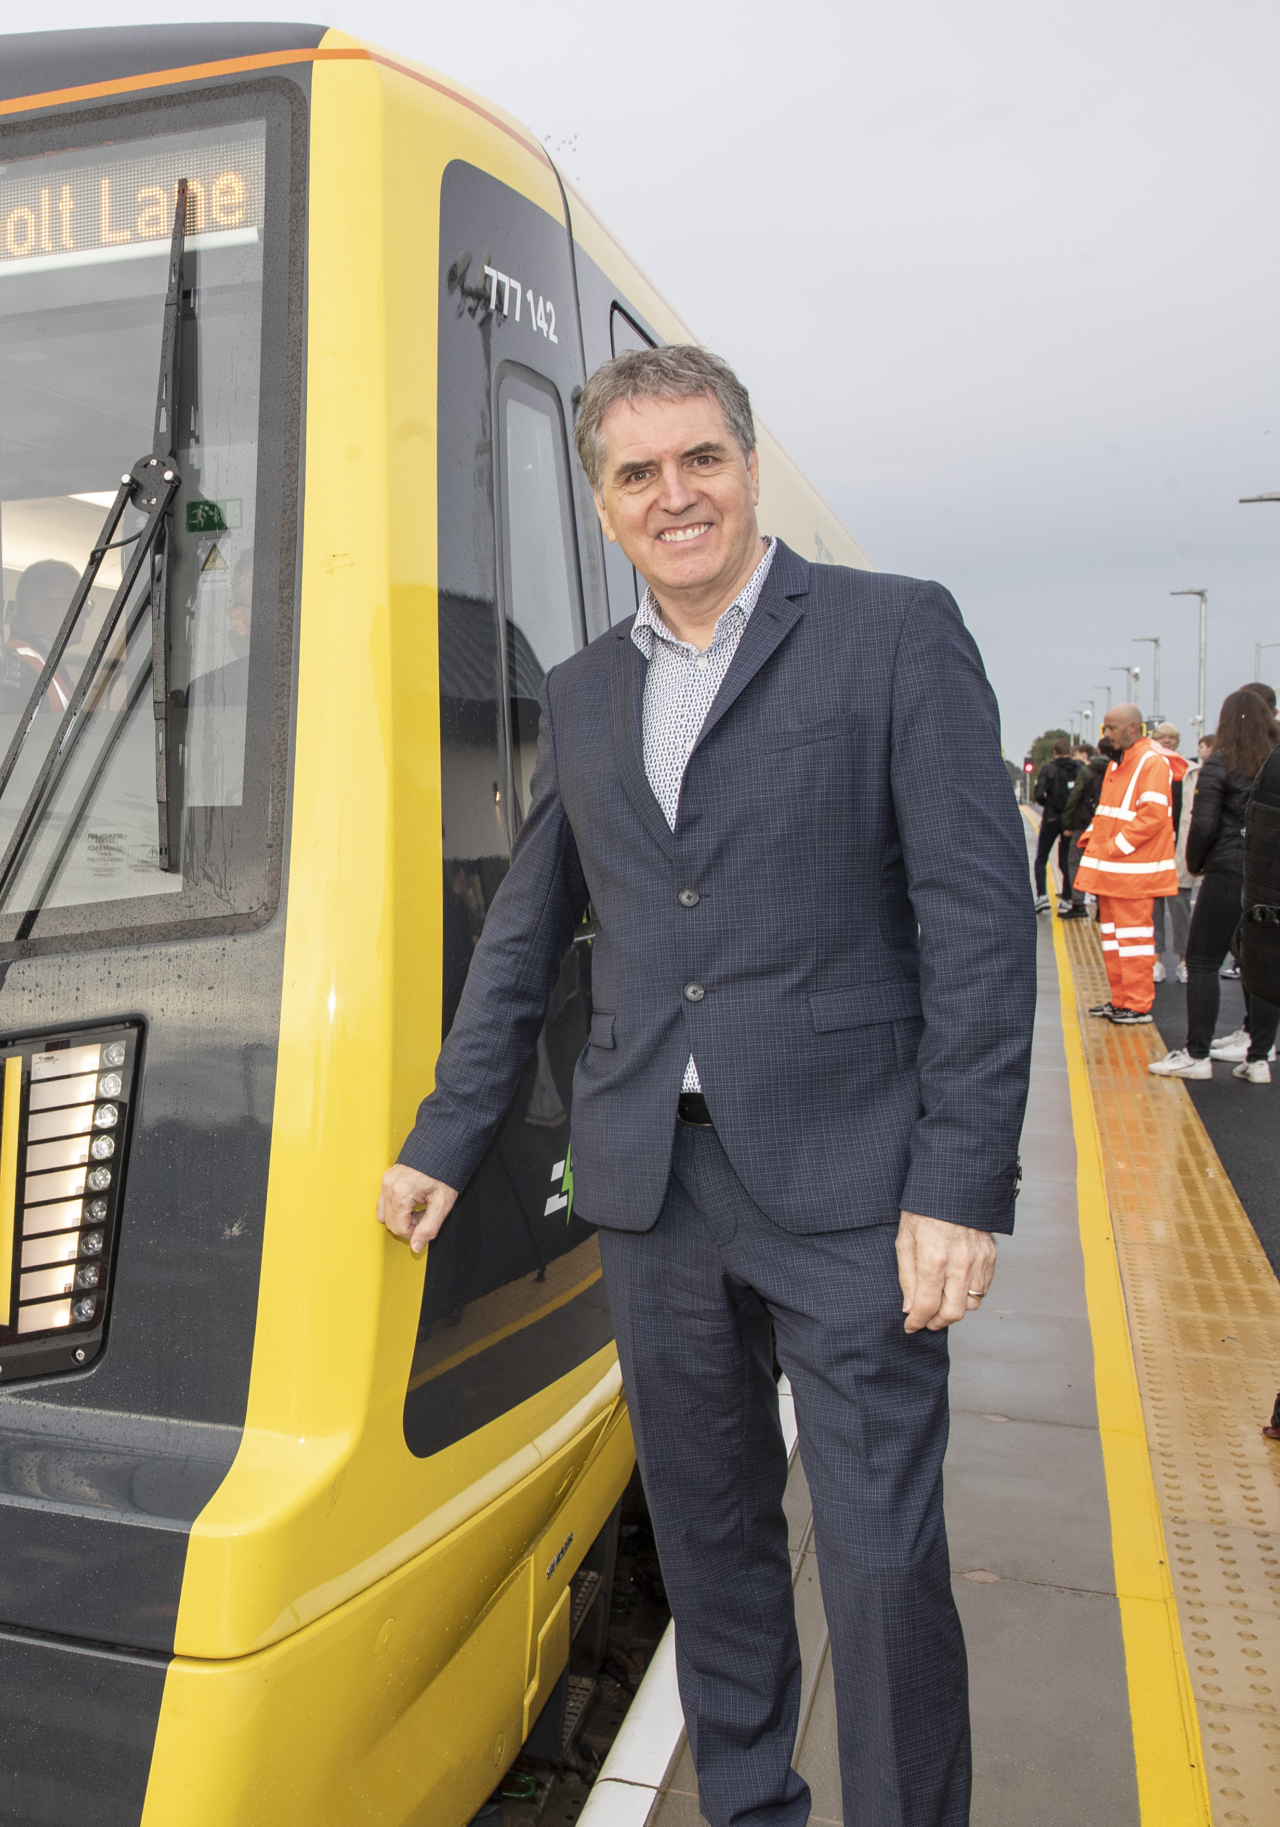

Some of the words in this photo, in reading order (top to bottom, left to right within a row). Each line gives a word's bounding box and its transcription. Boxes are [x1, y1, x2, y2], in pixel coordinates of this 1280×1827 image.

[100, 171, 245, 244] Lane
[484, 264, 521, 323] 777
[526, 289, 558, 344] 142
